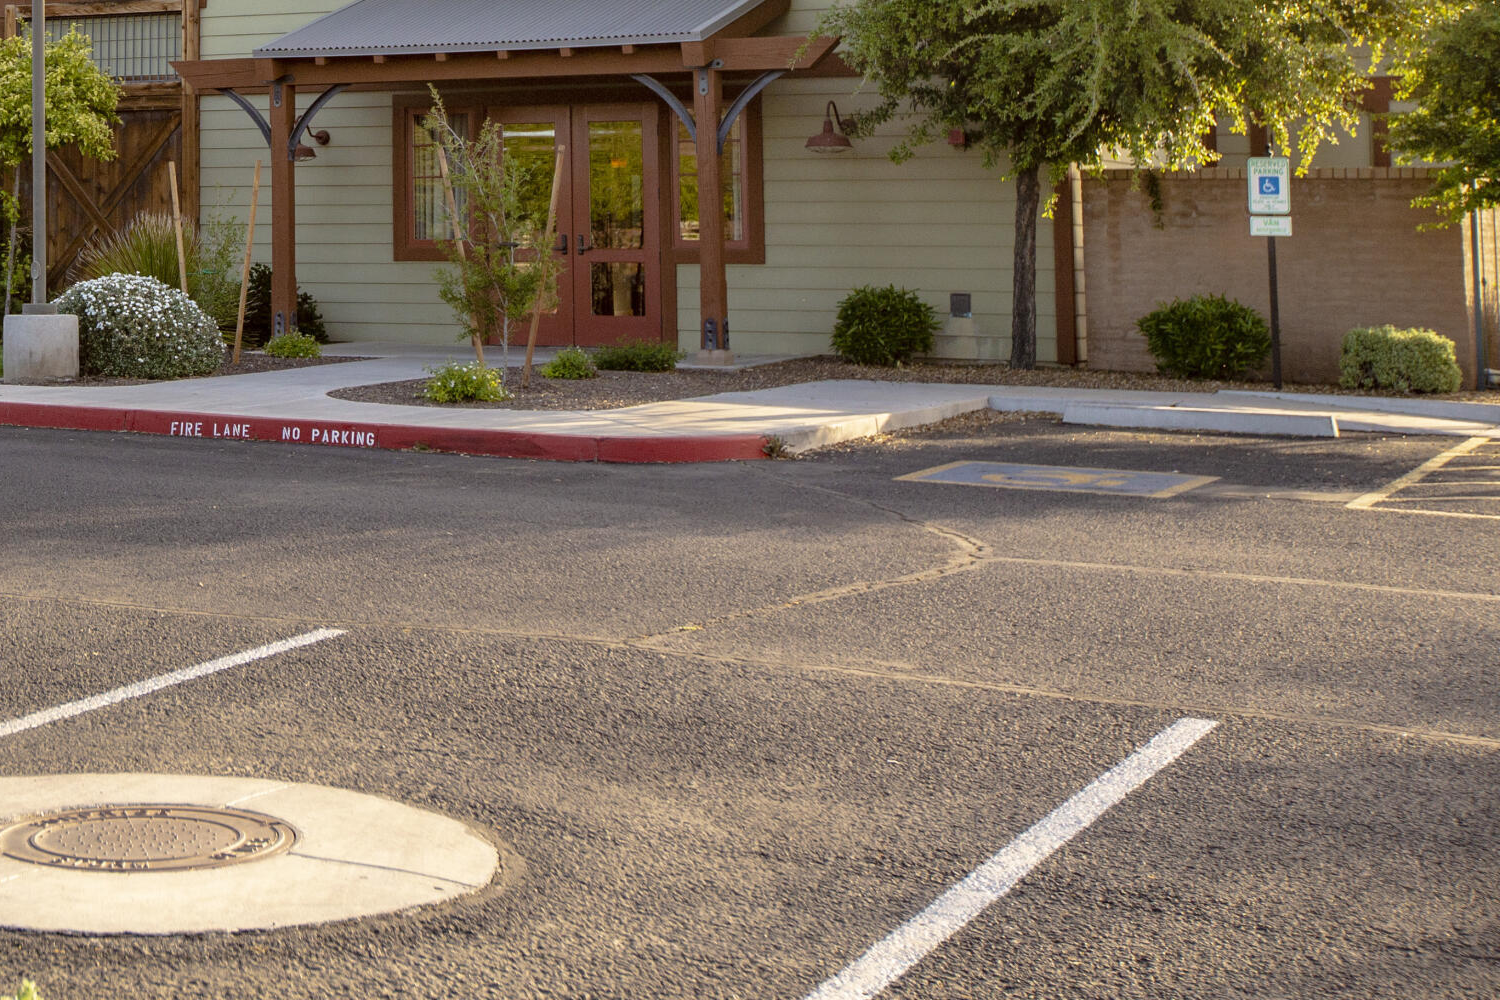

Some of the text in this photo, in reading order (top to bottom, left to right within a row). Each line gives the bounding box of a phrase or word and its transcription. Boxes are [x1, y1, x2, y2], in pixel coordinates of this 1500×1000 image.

[170, 421, 375, 446] FIRE LANE NO PARKING
